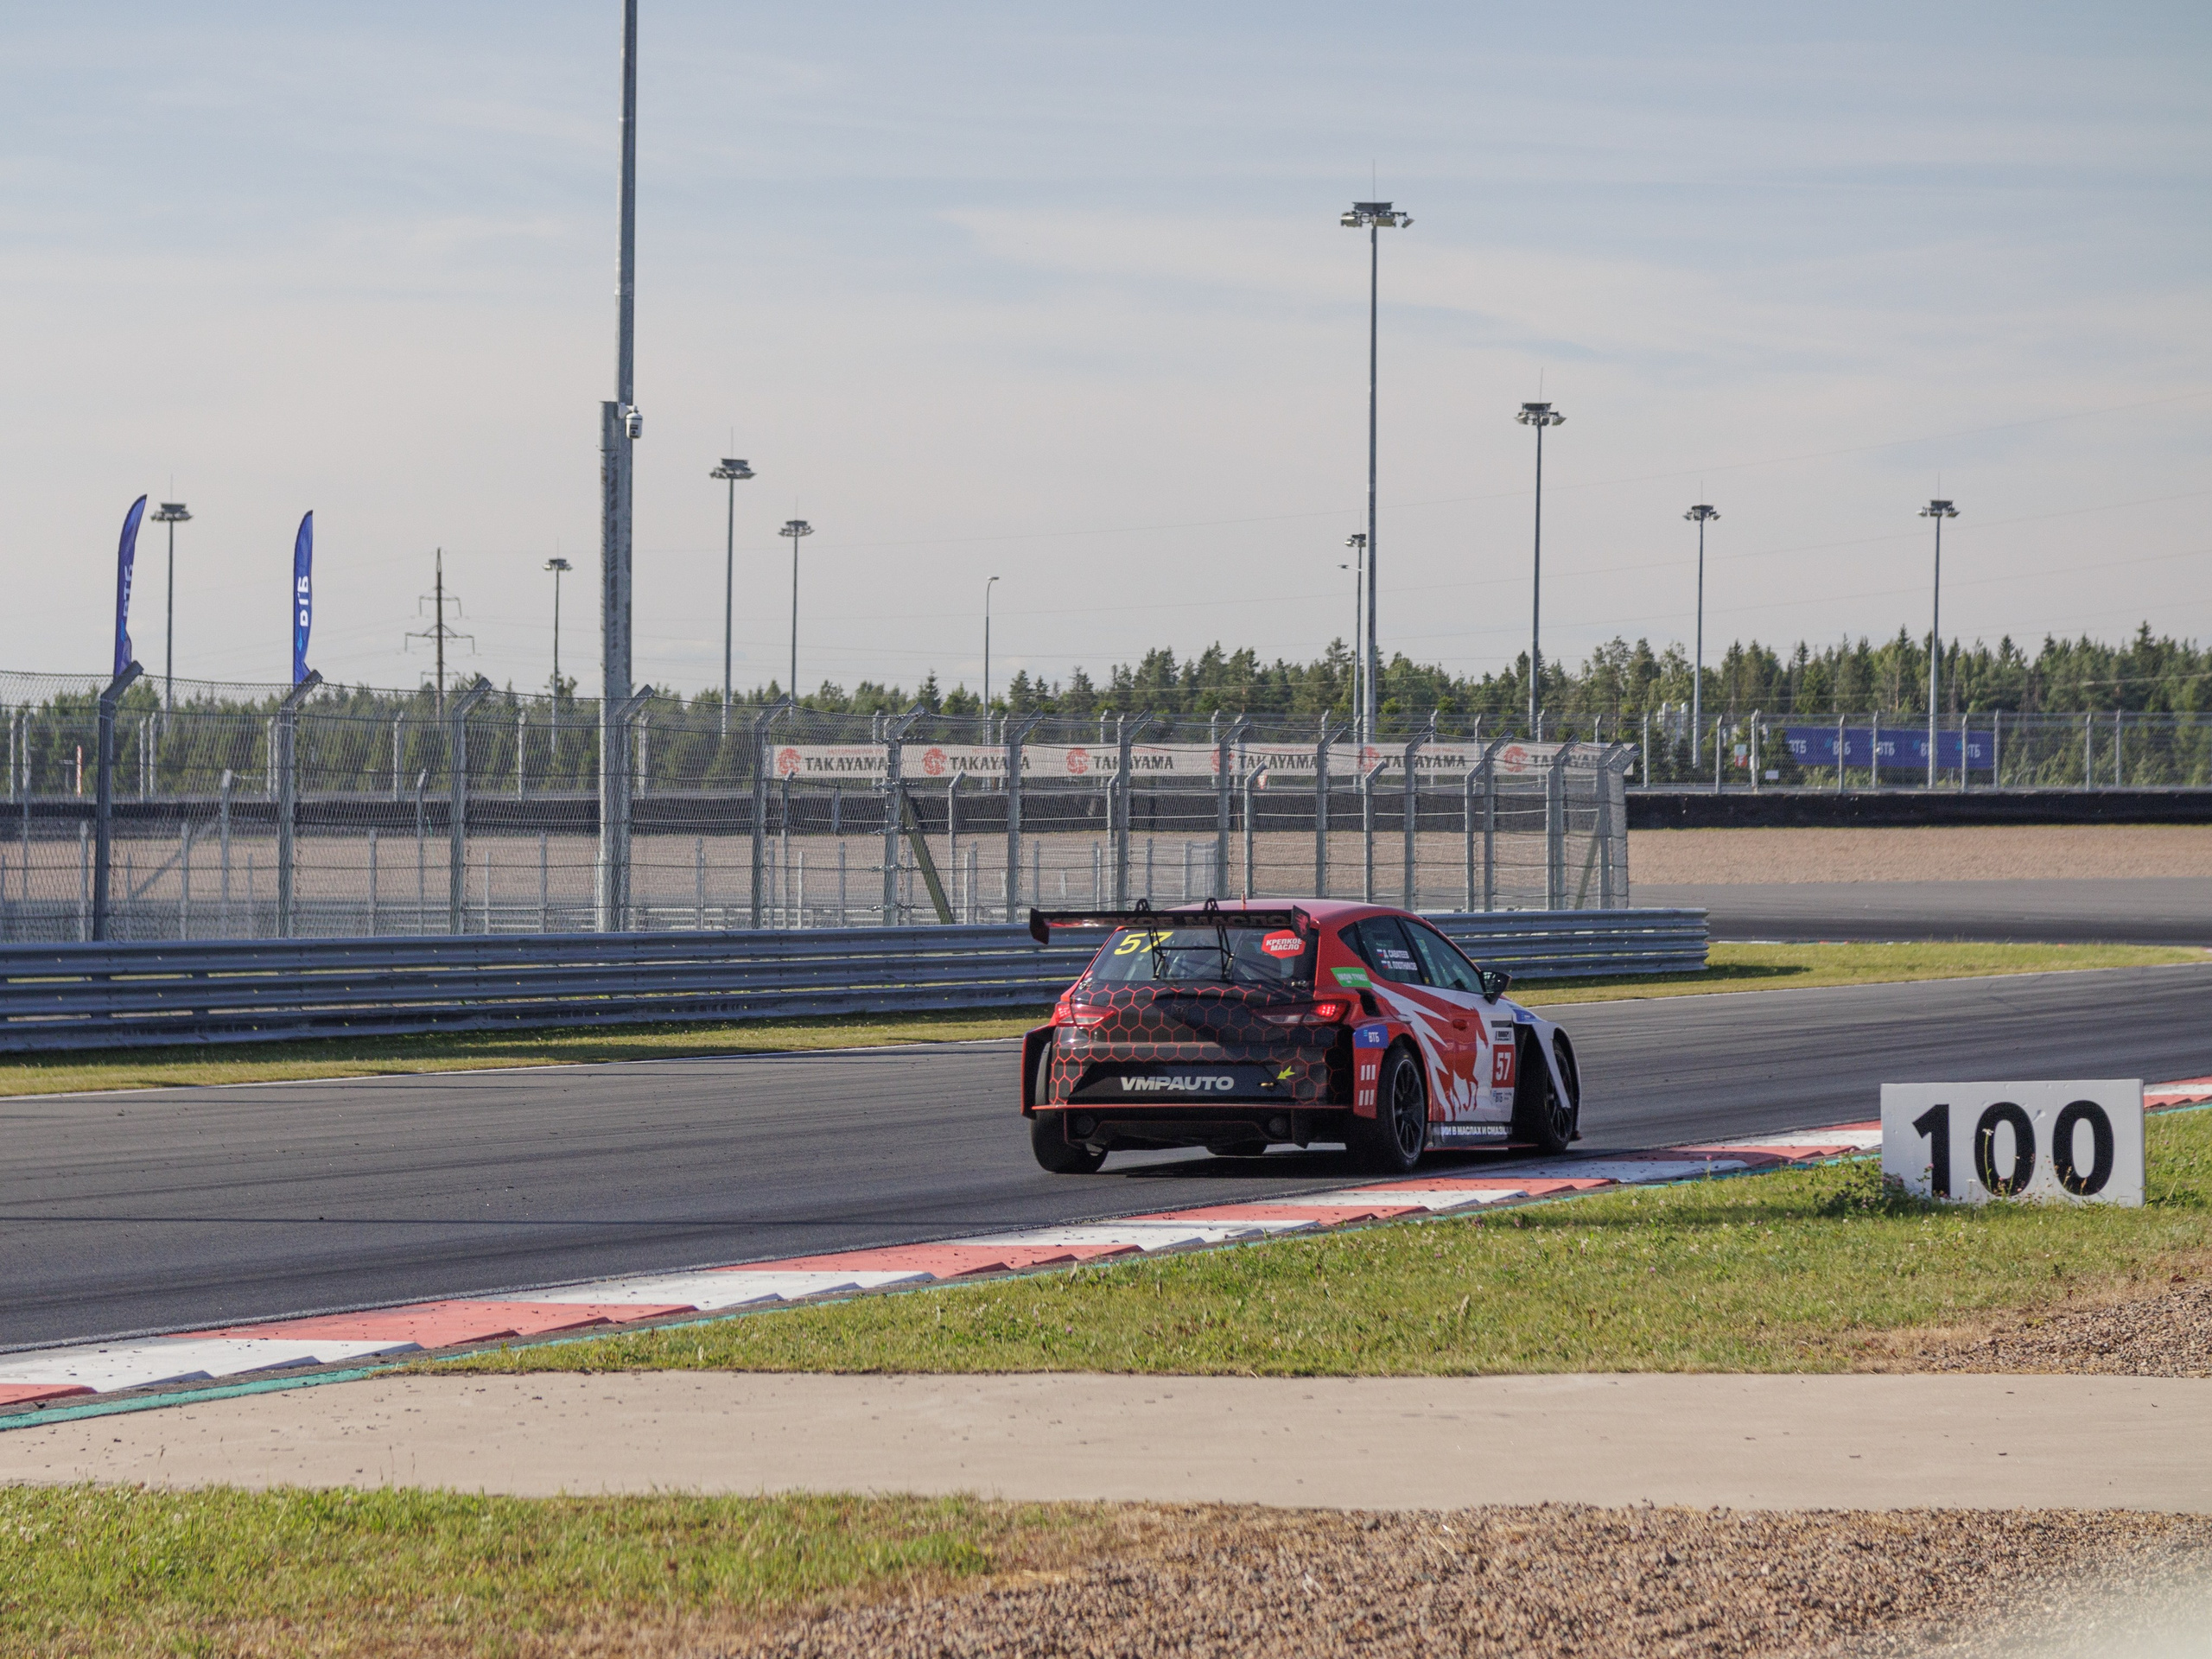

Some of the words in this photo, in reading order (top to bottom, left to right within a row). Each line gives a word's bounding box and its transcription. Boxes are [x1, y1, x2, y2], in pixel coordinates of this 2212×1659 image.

[1833, 741, 1851, 755] ВБ
[804, 757, 887, 771] TAKAYAMA
[950, 756, 1030, 770] TAKAYAA
[1383, 755, 1465, 767] TAAYAMA
[1114, 931, 1173, 956] 57
[1368, 1032, 1380, 1042] ВТБ
[1496, 1052, 1511, 1081] 57
[1121, 1077, 1234, 1090] VMPAUTO
[1912, 1100, 2114, 1198] 100
